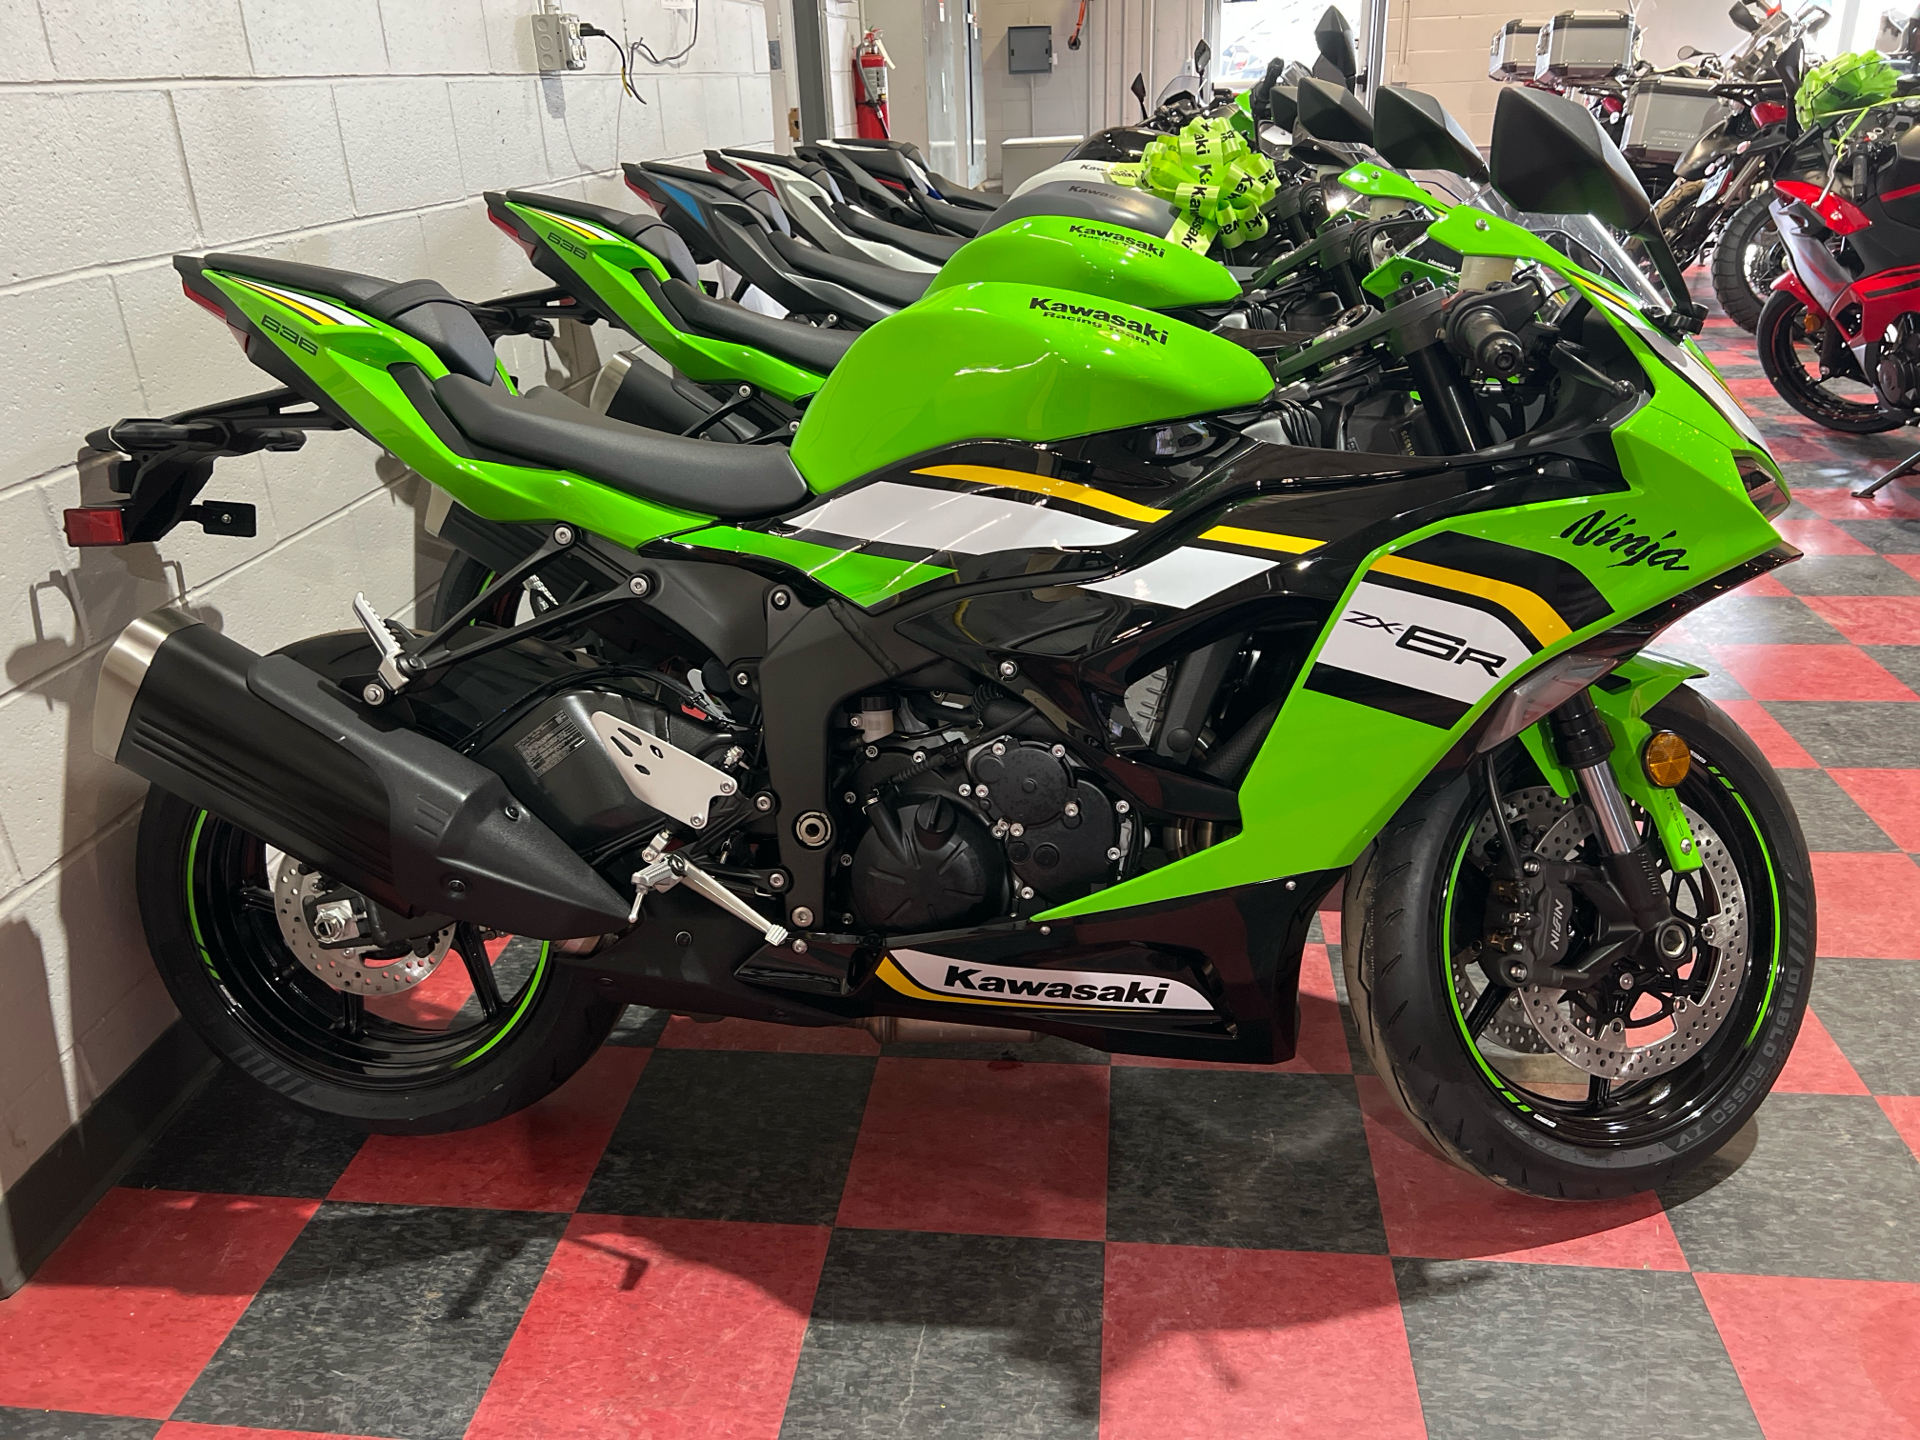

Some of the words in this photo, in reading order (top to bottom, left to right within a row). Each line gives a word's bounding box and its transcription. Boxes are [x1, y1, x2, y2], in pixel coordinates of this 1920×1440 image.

[547, 231, 588, 260] 636
[1069, 224, 1166, 258] Kawasaki
[261, 314, 318, 356] 636
[1029, 297, 1169, 345] Kawasaki
[1043, 311, 1102, 328] Racing
[1106, 323, 1150, 346] Team
[1559, 509, 1690, 571] Ninja
[1342, 610, 1508, 679] ZX-6R
[943, 965, 1170, 1005] Kawasaki
[1763, 967, 1800, 1058] DIABLO
[1711, 1061, 1766, 1125] ROSSO
